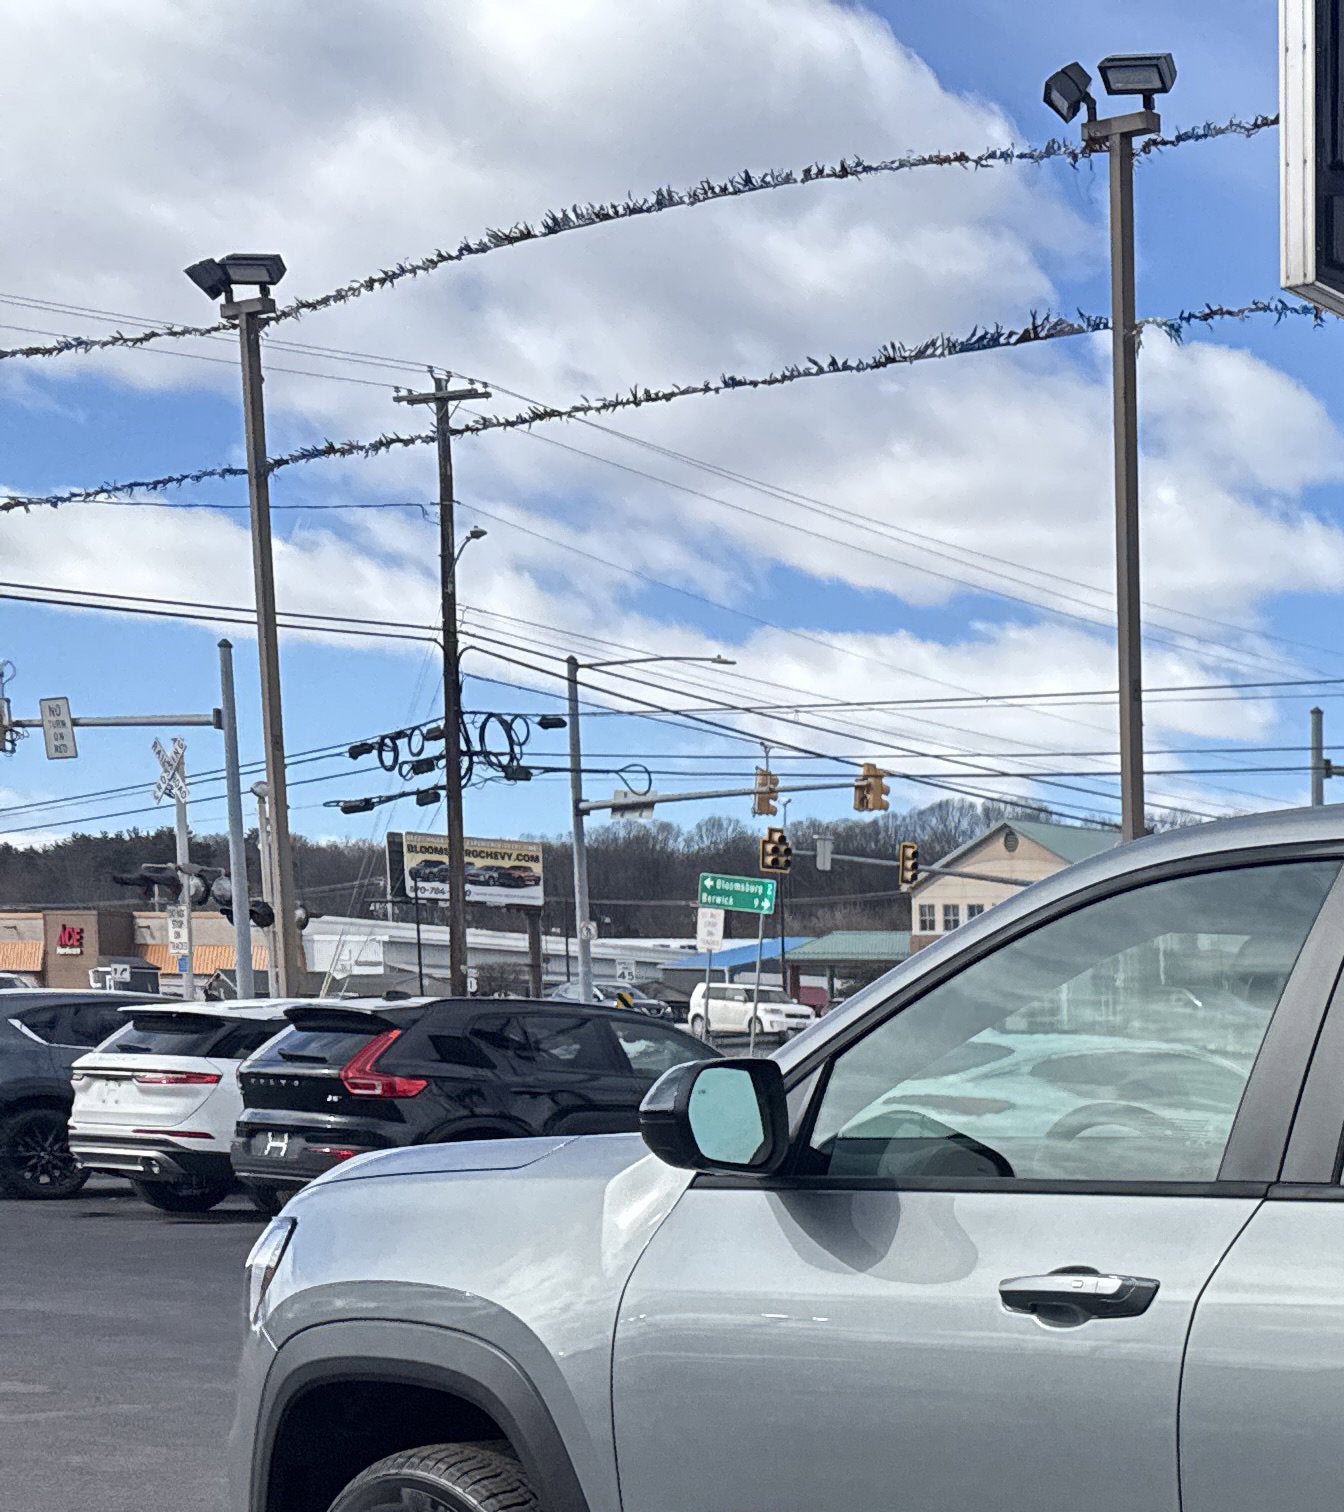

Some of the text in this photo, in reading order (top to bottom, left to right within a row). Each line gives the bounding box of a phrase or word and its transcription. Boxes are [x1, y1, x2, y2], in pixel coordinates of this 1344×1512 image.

[48, 704, 61, 717] NO
[53, 731, 65, 742] ON
[716, 879, 763, 895] Bloomsburg
[702, 892, 734, 906] Berwick
[57, 924, 81, 946] ACE
[617, 971, 634, 981] 45
